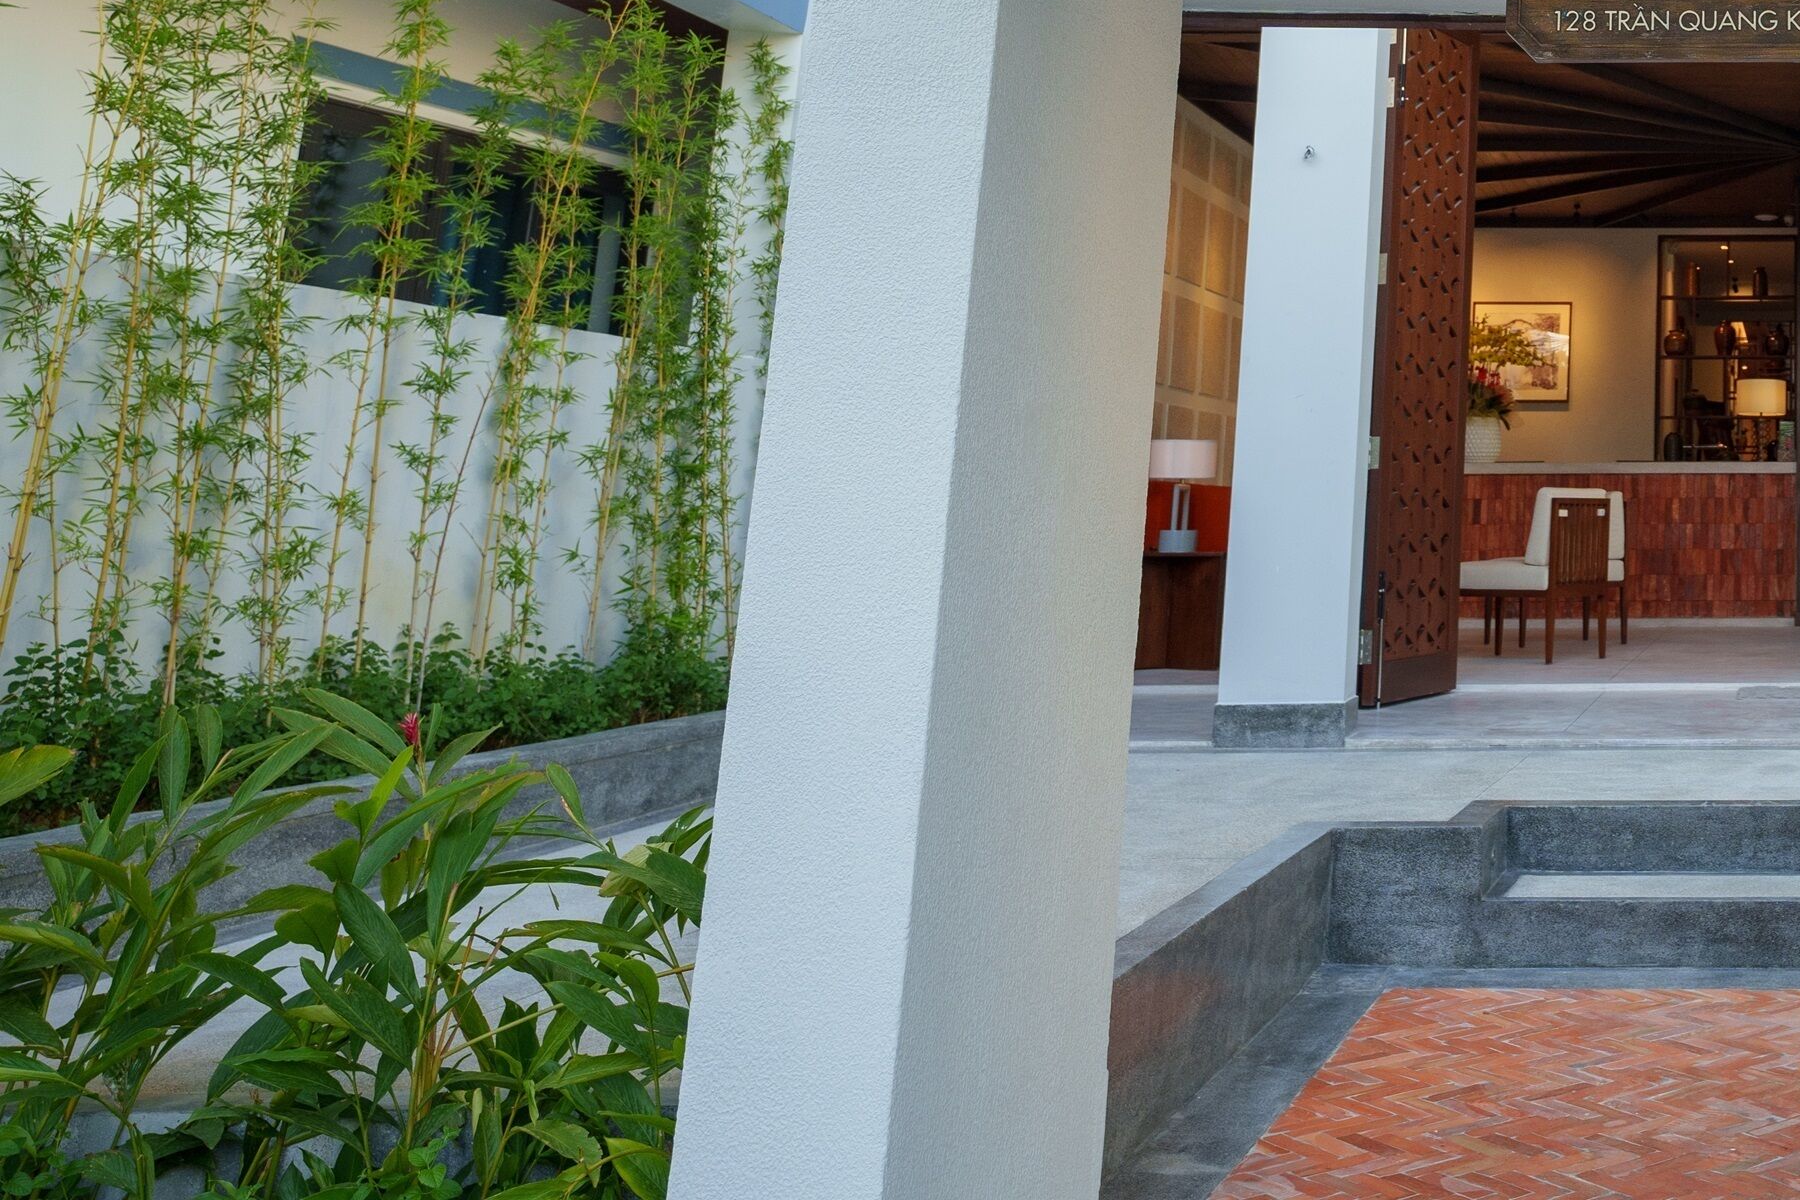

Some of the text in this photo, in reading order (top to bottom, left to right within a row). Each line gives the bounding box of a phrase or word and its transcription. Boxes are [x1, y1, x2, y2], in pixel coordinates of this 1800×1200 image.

[1554, 10, 1596, 32] 128
[1604, 2, 1670, 31] TRẦN
[1678, 9, 1778, 32] QUANG
